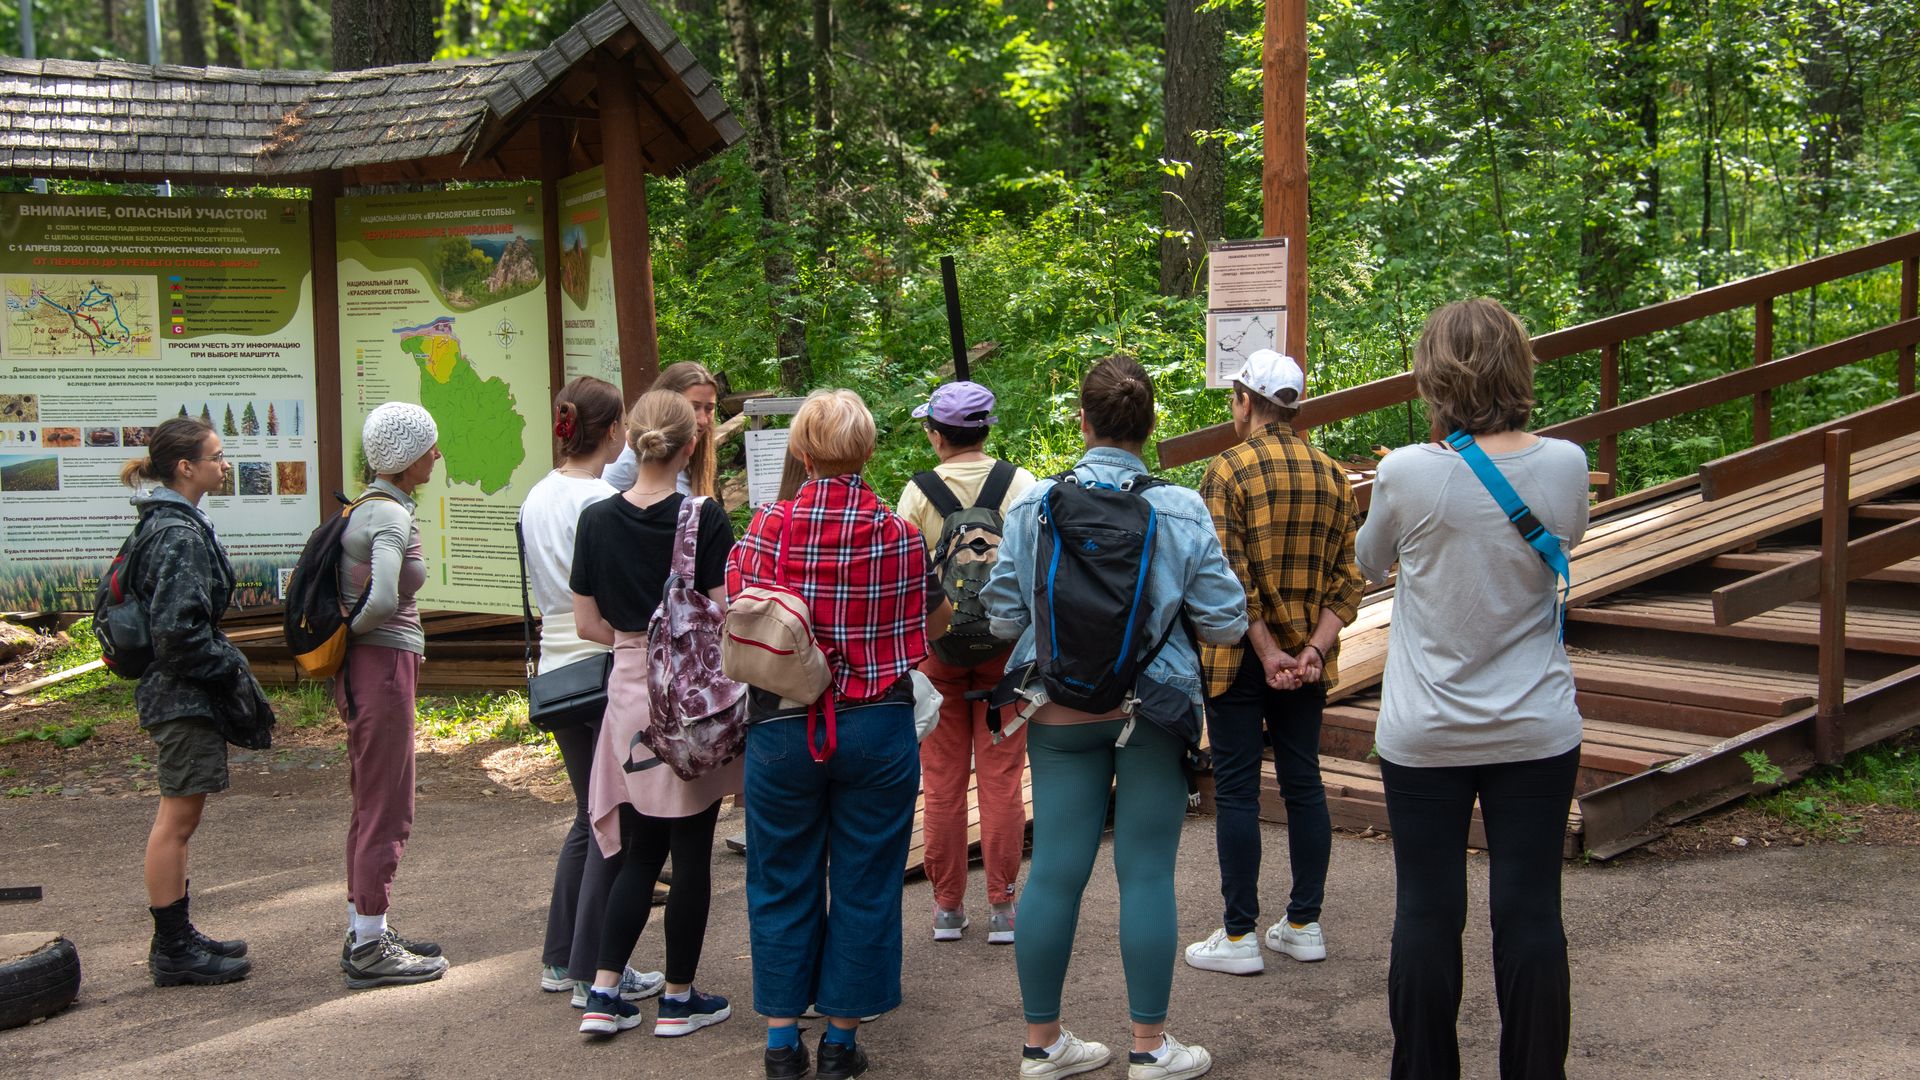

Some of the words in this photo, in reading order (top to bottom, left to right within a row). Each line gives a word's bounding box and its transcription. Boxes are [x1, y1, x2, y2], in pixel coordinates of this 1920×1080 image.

[19, 205, 111, 219] ВНИМАНИЕ,
[115, 206, 192, 219] ОПАСНЫЙ
[196, 208, 267, 220] УЧАСТОК!
[361, 213, 407, 223] НАЦИОНАЛЬНЫЙ
[424, 209, 480, 220] «КРАСНОЯРСКИЕ
[482, 208, 515, 217] СТОЛБЫ»
[85, 245, 109, 253] ГОДА
[152, 246, 232, 254] ТУРИСТИЧЕСКОГО
[50, 258, 99, 266] ПЕРВОГО
[102, 259, 117, 267] ДО
[347, 279, 392, 287] НАЦИОНАЛЬНЫЙ
